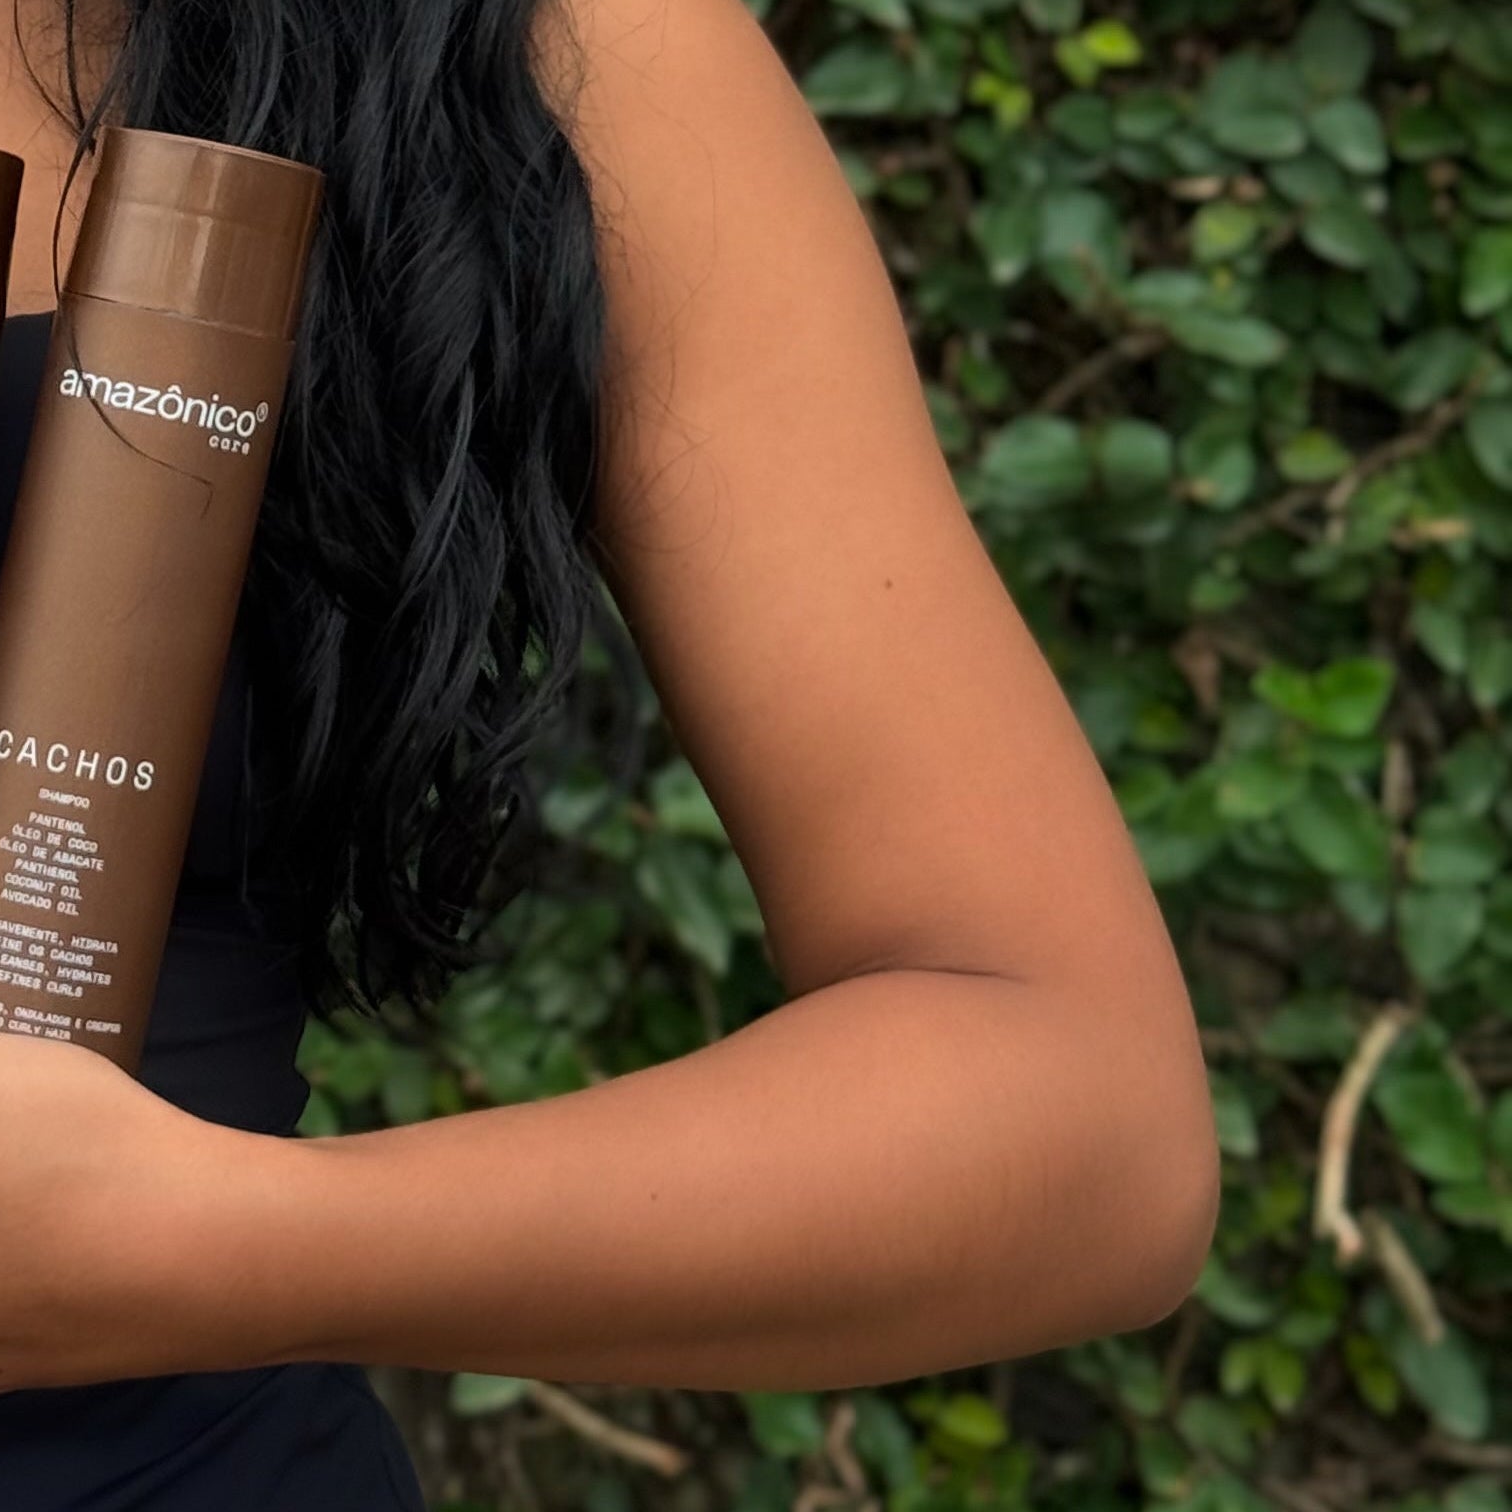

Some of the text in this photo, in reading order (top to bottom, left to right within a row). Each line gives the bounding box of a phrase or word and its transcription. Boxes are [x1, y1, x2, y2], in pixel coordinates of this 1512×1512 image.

[209, 435, 250, 455] care
[39, 788, 90, 809] SHAMPOO
[29, 811, 87, 835] PANTENOL
[12, 823, 98, 854] ÓLEO DE COCO
[0, 837, 105, 872] ÓLEO DE ABACATE
[14, 858, 79, 883] PANTHENOL
[4, 873, 82, 900] COCONUT OIL
[0, 888, 80, 916] AVOCADO OIL
[28, 943, 45, 957] OS
[50, 948, 94, 967] CACHOS
[71, 936, 119, 954] HIDRATA
[56, 966, 112, 986] HYDRATES
[46, 981, 84, 998] CURLS
